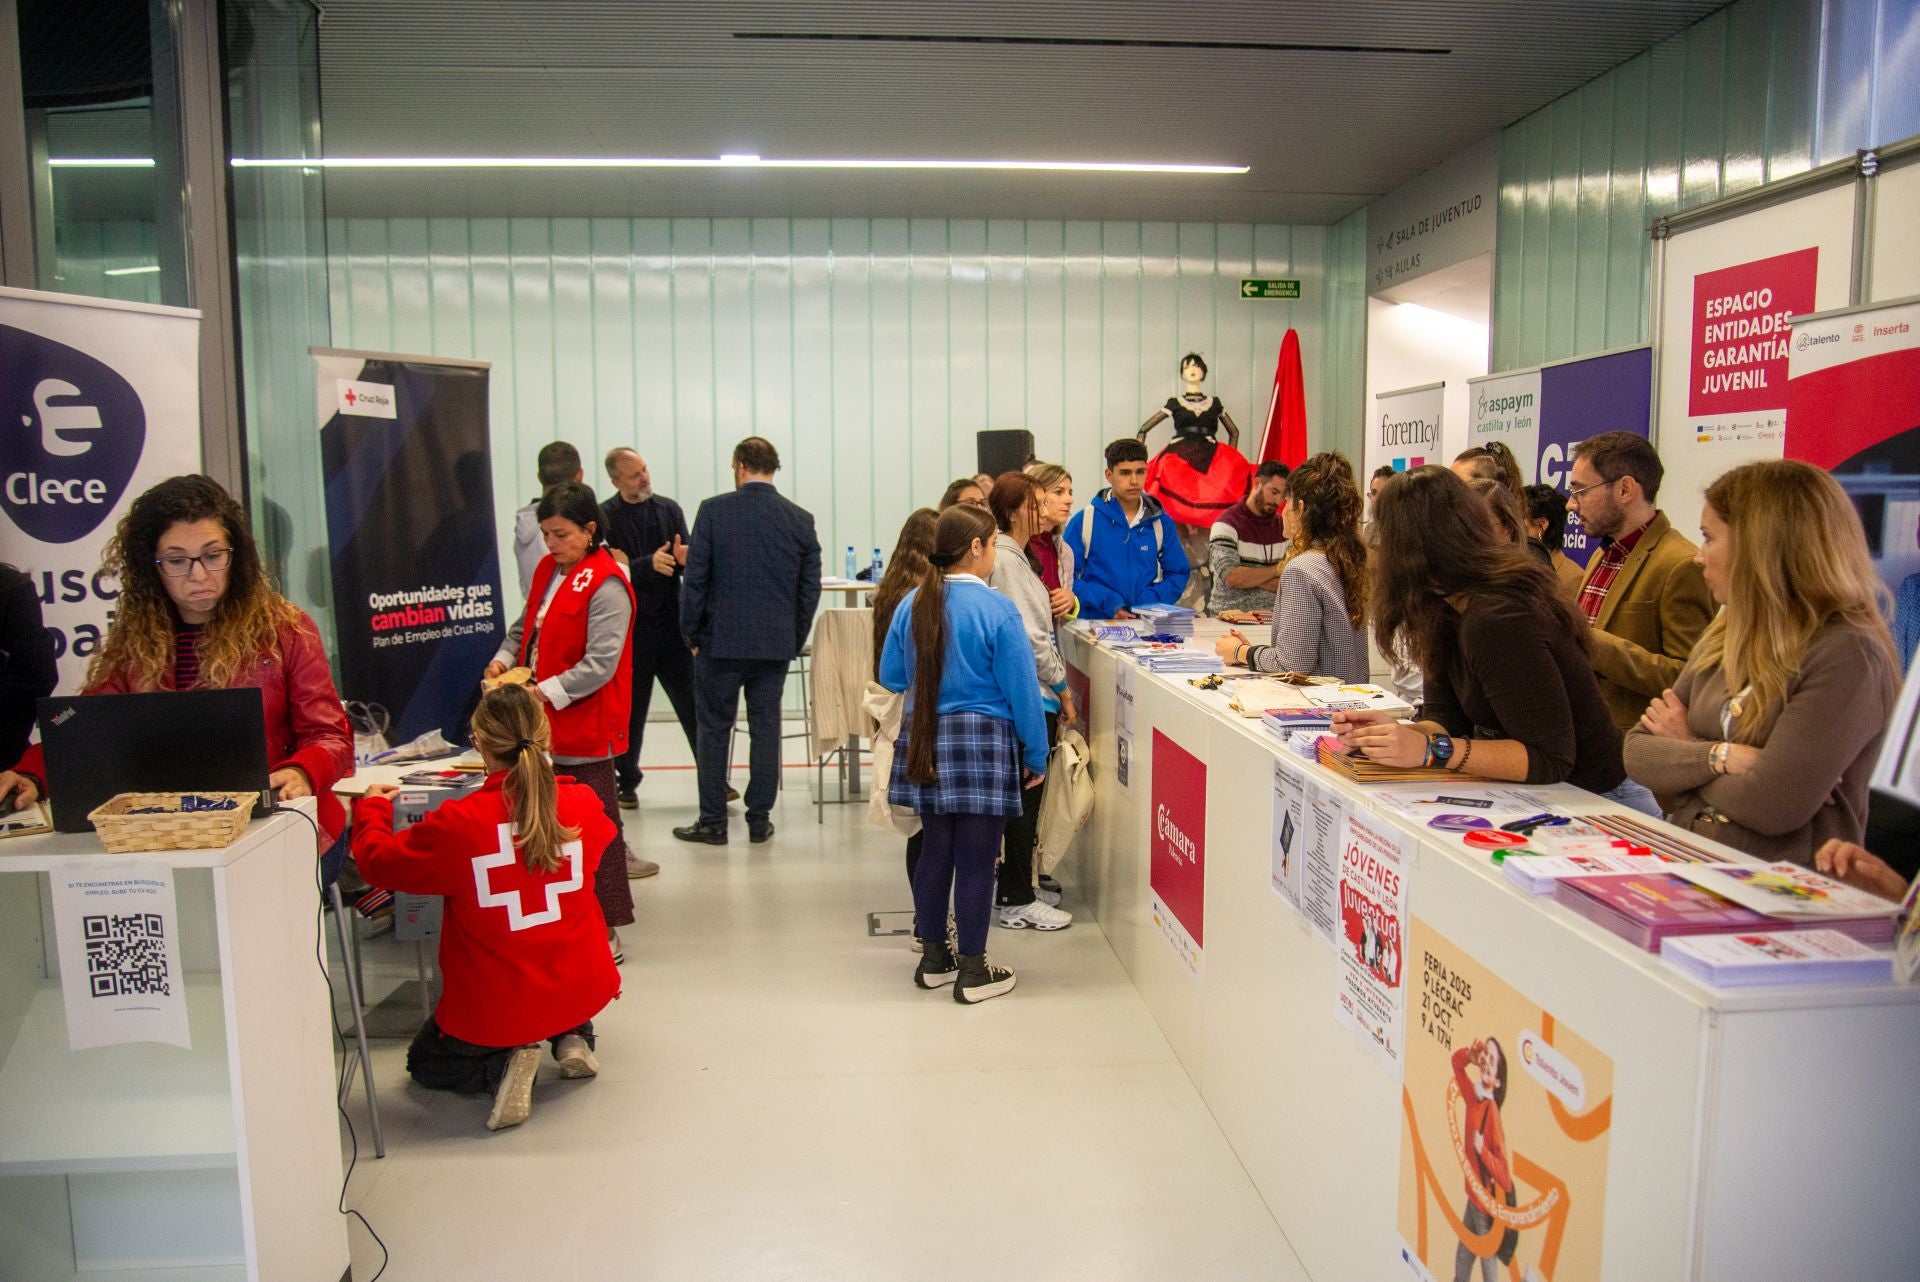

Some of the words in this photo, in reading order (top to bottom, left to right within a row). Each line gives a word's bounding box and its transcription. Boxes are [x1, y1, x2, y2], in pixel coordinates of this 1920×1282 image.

[1396, 225, 1415, 245] SALA
[1418, 218, 1430, 235] DE
[1432, 194, 1482, 233] JUVENTUD
[1395, 254, 1420, 274] AULAS
[1706, 288, 1772, 318] ESPACIO
[1704, 310, 1792, 344] ENTIDADES
[1873, 322, 1910, 336] Inserta
[1704, 334, 1789, 368] GARANTÍA
[1702, 368, 1768, 394] JUVENIL
[360, 394, 374, 403] Cruz
[376, 396, 390, 406] Roja
[1489, 393, 1533, 414] aspaym
[1381, 413, 1440, 451] foremcyl
[1476, 418, 1503, 434] castilla
[1506, 418, 1512, 432] y
[1514, 416, 1532, 430] león
[6, 472, 107, 505] Clece
[369, 585, 464, 611] Oportunidades
[466, 584, 492, 600] que
[371, 603, 446, 631] cambian
[447, 599, 494, 620] vidas
[372, 636, 390, 648] Plan
[392, 634, 404, 646] de
[405, 629, 441, 643] Empleo
[442, 626, 452, 637] de
[453, 624, 474, 635] Cruz
[475, 620, 494, 633] Roja
[1344, 841, 1400, 897] JÓVENES
[1342, 864, 1349, 876] DE
[1350, 869, 1376, 895] CASTILLA
[1382, 895, 1398, 912] LEÓN
[1424, 951, 1447, 982] FERIA
[1450, 971, 1472, 1002] 2025
[1422, 992, 1430, 1011] 21
[1433, 1002, 1454, 1032] OCT.
[1431, 978, 1464, 1018] LÉCRAC
[1422, 1012, 1426, 1028] 9
[1428, 1021, 1434, 1036] A
[1437, 1026, 1451, 1051] 17H
